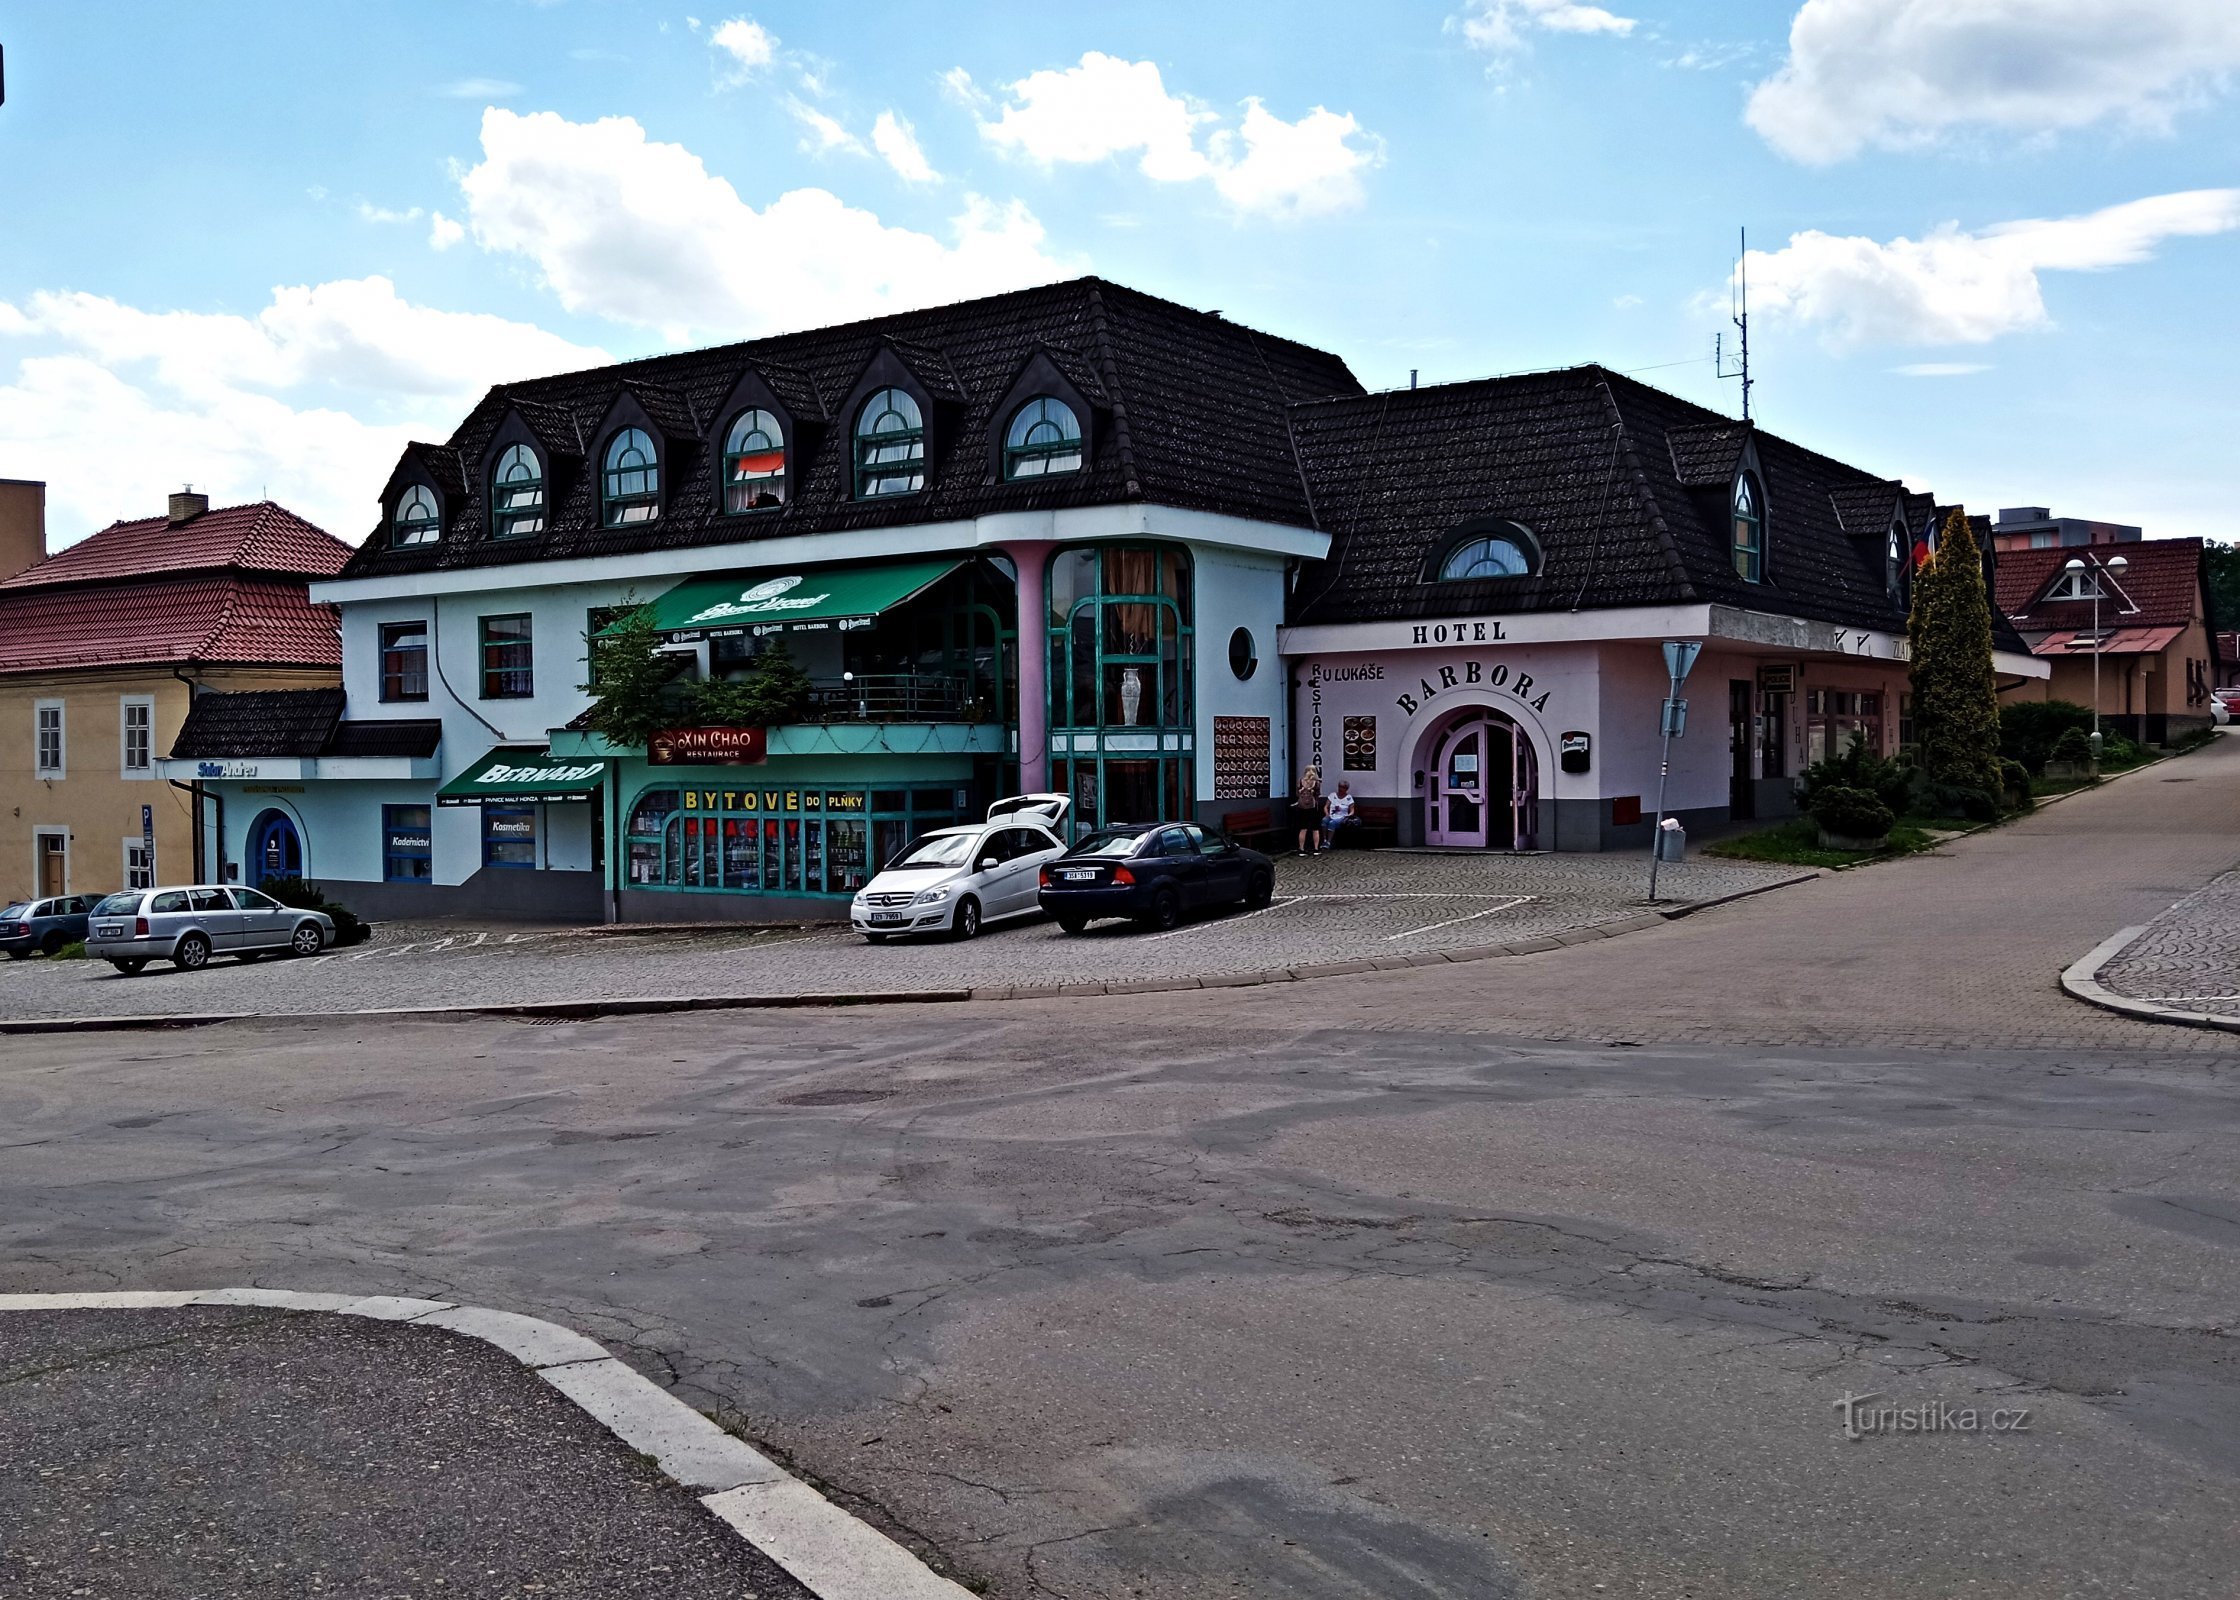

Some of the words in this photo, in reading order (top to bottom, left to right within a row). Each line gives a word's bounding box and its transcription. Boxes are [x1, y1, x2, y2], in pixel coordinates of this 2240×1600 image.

[1412, 621, 1506, 644] HOTEL
[1893, 640, 1911, 659] ZLAT
[1322, 668, 1332, 681] U
[1334, 663, 1384, 681] LUKÁŠE
[1396, 661, 1551, 716] BARBORA
[1311, 663, 1323, 783] RESTAURAN
[678, 731, 706, 749] XIN
[710, 731, 751, 748] CHAO
[686, 750, 740, 758] RESTAURACE
[221, 762, 258, 777] Andrea
[474, 762, 605, 783] BERNARD
[143, 808, 150, 825] P
[492, 822, 530, 832] Kosmetika
[392, 836, 430, 847] Kadeřnictví
